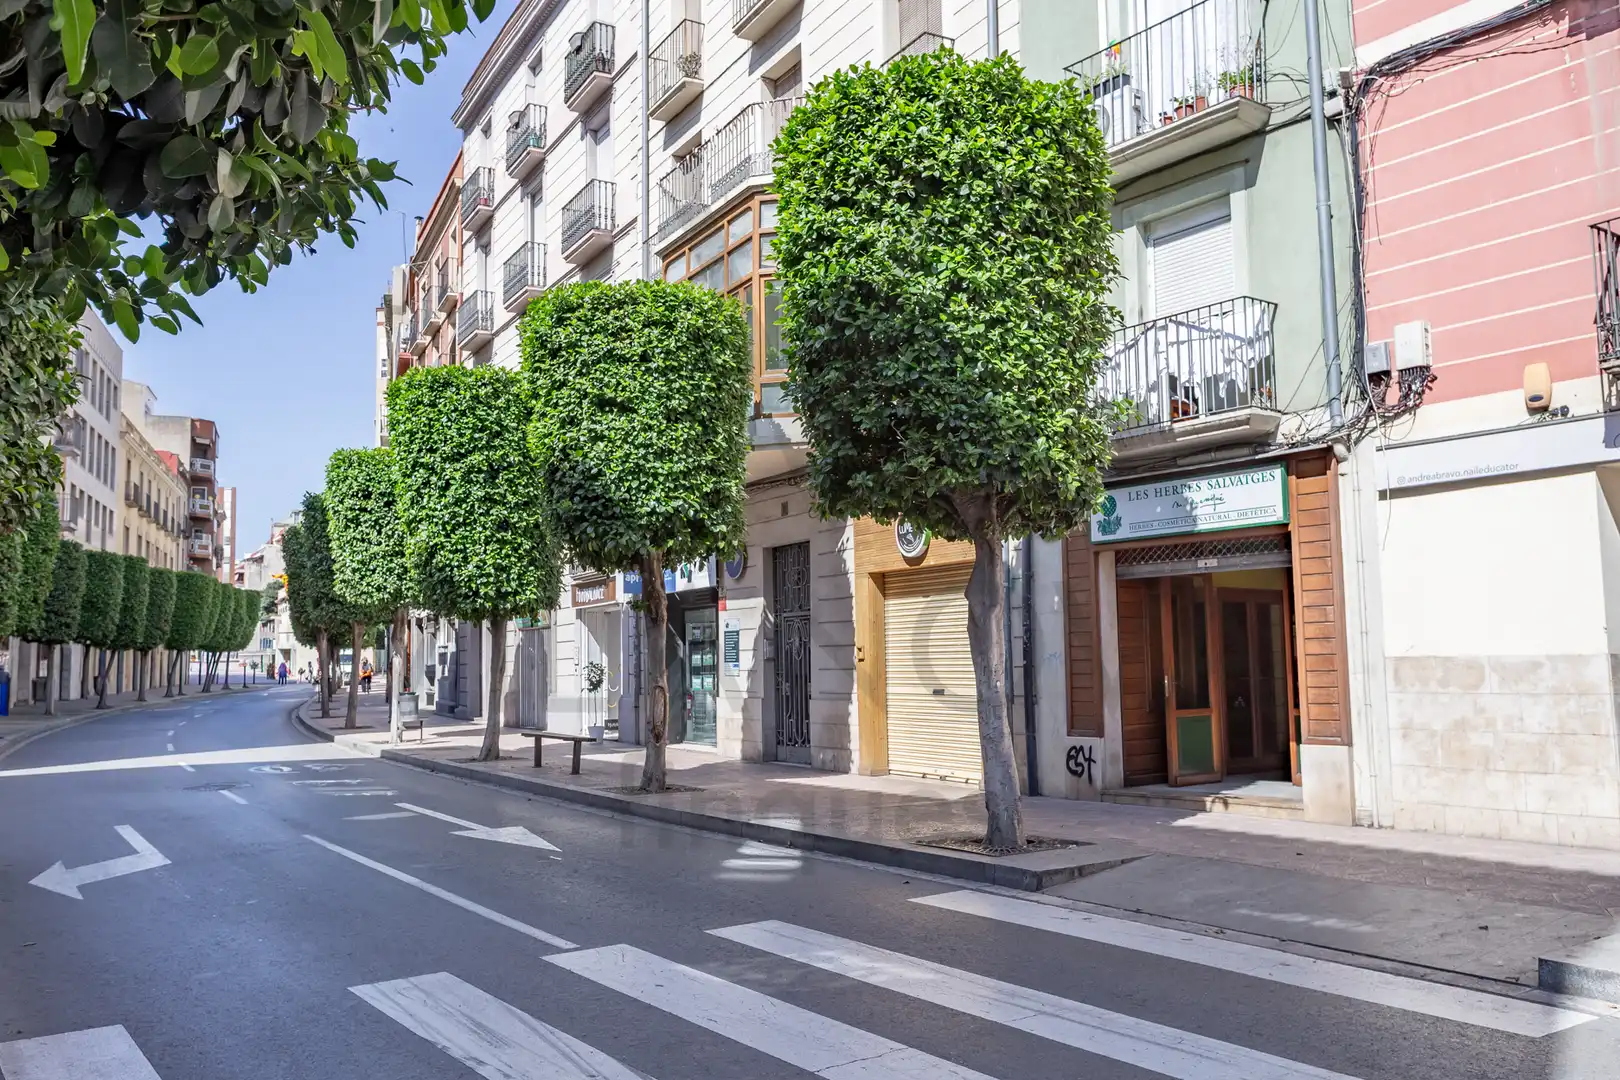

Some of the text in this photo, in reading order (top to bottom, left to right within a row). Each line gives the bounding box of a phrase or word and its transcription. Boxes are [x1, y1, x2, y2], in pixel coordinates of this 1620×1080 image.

[1396, 462, 1519, 485] @andreabravo.naileducator
[1127, 471, 1276, 502] LES HERBES SALVATGES
[1129, 522, 1154, 531] HERBES
[1197, 513, 1230, 523] NATURAL
